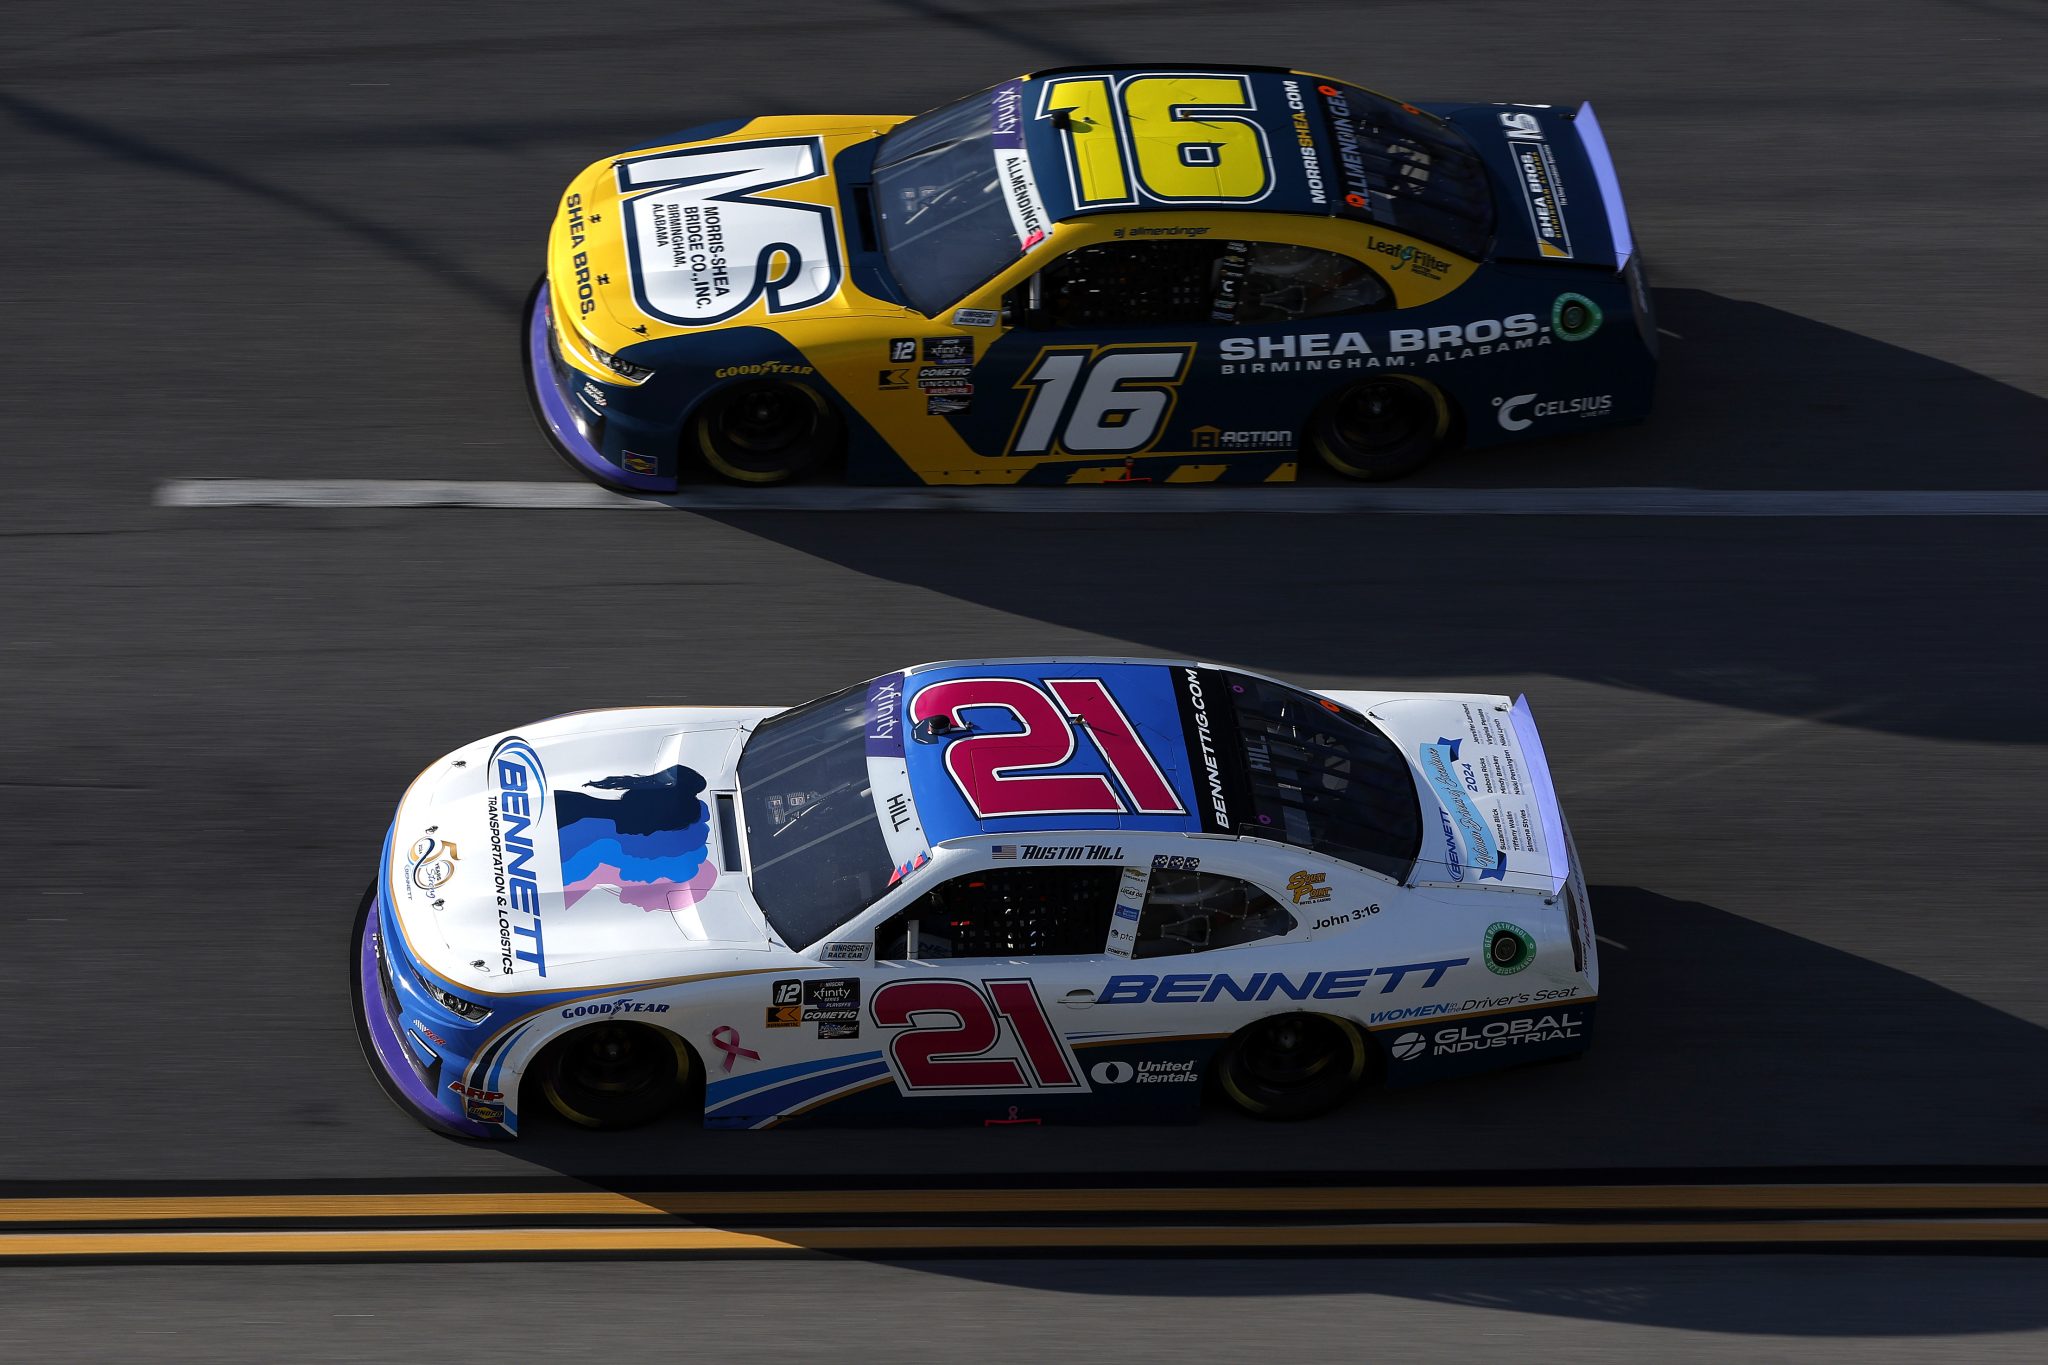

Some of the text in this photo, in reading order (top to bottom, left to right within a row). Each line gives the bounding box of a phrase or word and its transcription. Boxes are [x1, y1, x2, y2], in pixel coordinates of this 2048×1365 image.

[992, 87, 1022, 135] xfinity
[1034, 72, 1276, 210] 16
[1282, 80, 1327, 205] MORRISSHEA.COM
[1006, 157, 1041, 236] ALLMENDINGE
[652, 203, 669, 248] ALABAMA
[683, 206, 704, 251] BRIDGE
[1534, 196, 1556, 238] SHEA
[667, 203, 687, 268] BIRMINGHAM,
[1114, 226, 1210, 238] aj allmendinger
[567, 192, 596, 321] SHEA BROS.
[703, 206, 731, 297] MORRIS-SHEA
[1368, 236, 1402, 257] Leaf
[1414, 251, 1452, 274] Filter
[930, 344, 966, 356] xfinity
[1219, 332, 1372, 361] SHEA
[1390, 312, 1551, 354] BROS.
[892, 342, 916, 360] 12
[1221, 335, 1553, 375] BIRMINGHAM, ALABAMA
[715, 361, 814, 378] GOODYEAR
[920, 368, 972, 377] COMETIC
[920, 380, 963, 388] LINCOLN
[1006, 342, 1198, 457] 16
[1533, 394, 1613, 417] CELSIUS
[1221, 430, 1292, 443] ACTION
[869, 683, 902, 739] xfinity
[907, 677, 1192, 818] 21
[1185, 668, 1229, 829] BENNETTIG.COM
[1462, 763, 1478, 792] 2024
[1483, 773, 1493, 793] Debora
[1498, 776, 1508, 794] Mindy
[887, 793, 910, 832] HILL
[1492, 808, 1501, 823] Blick
[1518, 809, 1529, 828] Styles
[1439, 807, 1461, 874] BENNETT
[1496, 823, 1506, 850] Suzanne
[1509, 829, 1520, 851] Tiffany
[1523, 828, 1534, 852] Simona
[1021, 845, 1124, 860] AUSTIN HILL
[498, 758, 547, 978] BENNETT
[426, 867, 436, 899] Strong
[487, 796, 513, 975] TRANSPORTATION & LOGISTICS
[1120, 887, 1135, 896] LUCAS
[1312, 903, 1380, 930] John 3:16
[1119, 933, 1134, 942] ptc
[775, 983, 801, 1004] 12
[813, 988, 851, 1002] xfinity
[1096, 957, 1470, 1005] BENNETT
[562, 998, 670, 1019] GOODYEAR
[804, 1009, 858, 1020] COMETIC
[1370, 1004, 1452, 1024] WOMEN
[1461, 993, 1529, 1011] Driver's
[1532, 986, 1579, 1001] Seat
[423, 1028, 447, 1047] RCR
[868, 977, 1084, 1093] 21
[1433, 1028, 1581, 1056] INDUSTRIAL
[1434, 1013, 1583, 1044] GLOBAL
[1136, 1072, 1198, 1084] Rentals
[1138, 1060, 1194, 1073] United
[449, 1081, 505, 1101] ARP
